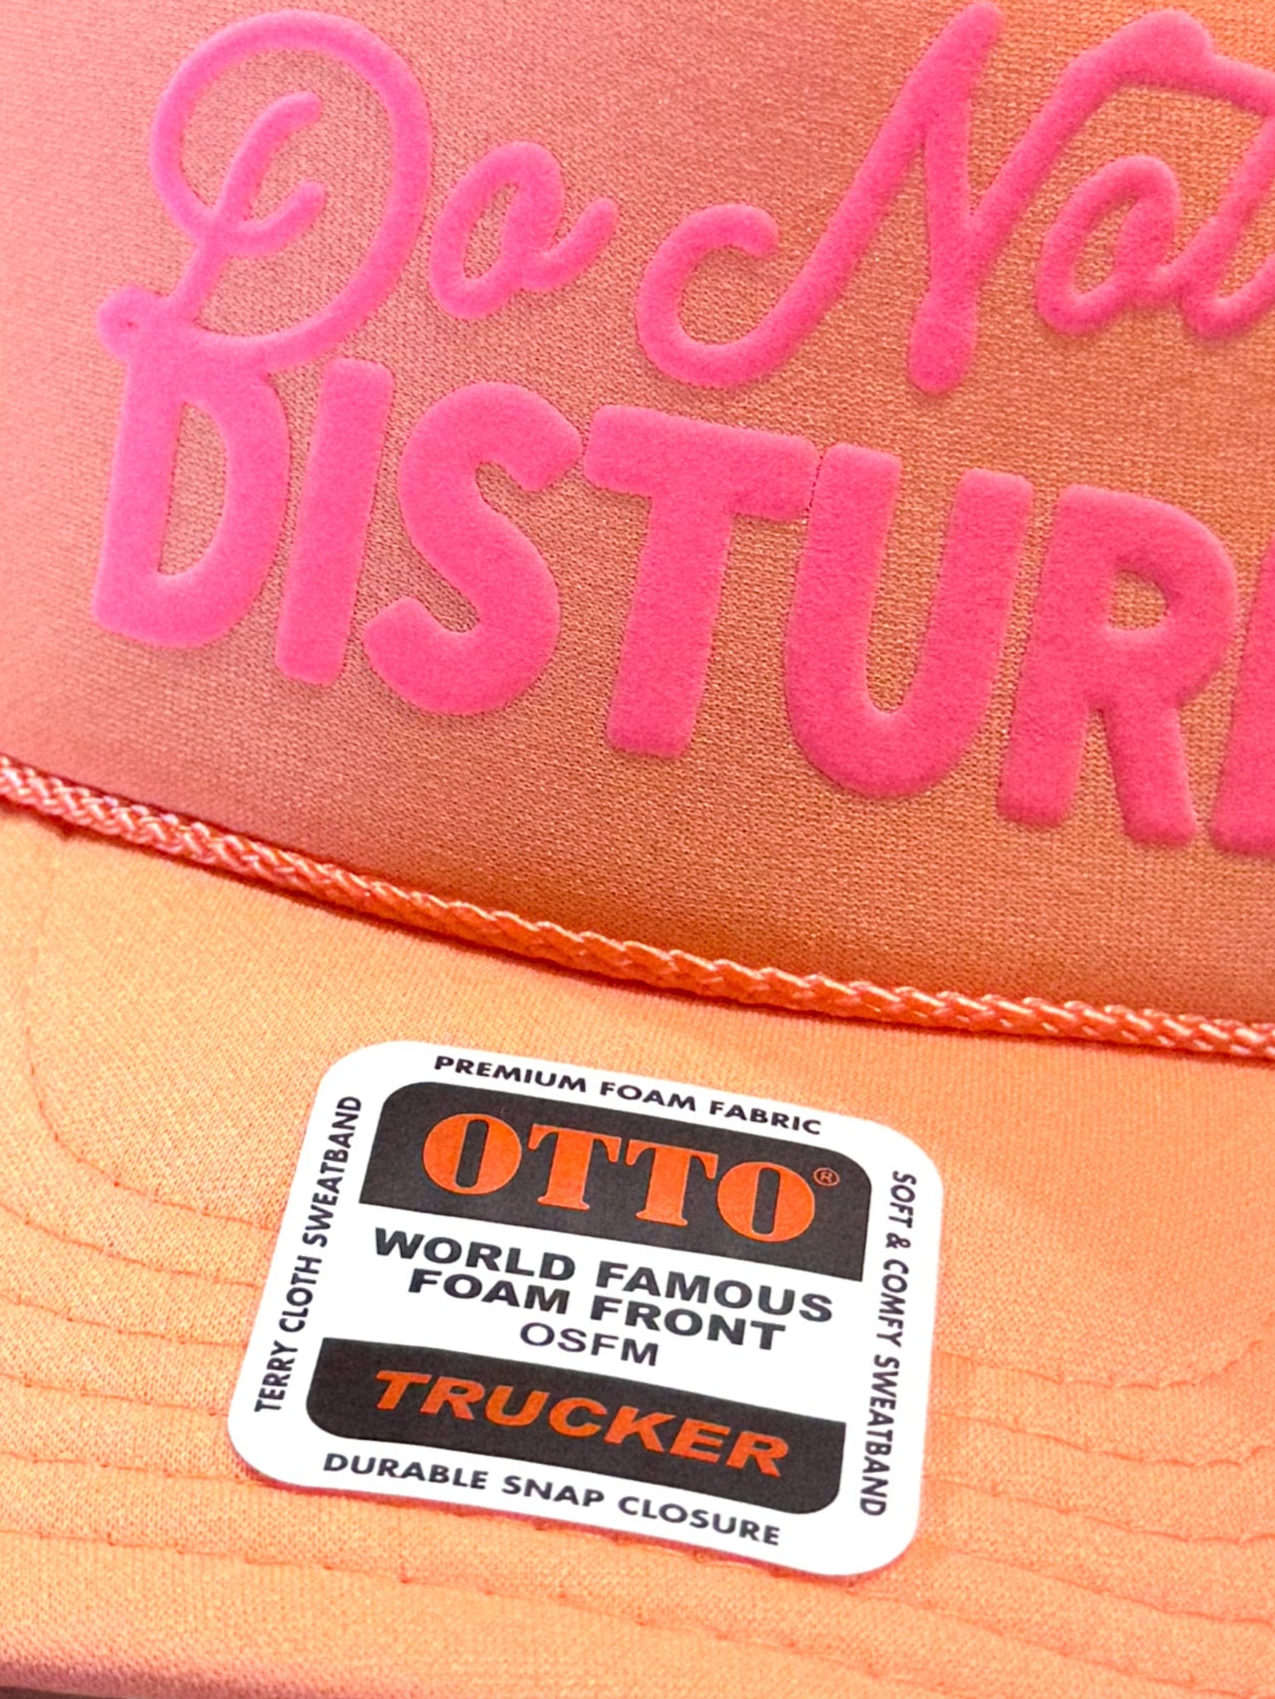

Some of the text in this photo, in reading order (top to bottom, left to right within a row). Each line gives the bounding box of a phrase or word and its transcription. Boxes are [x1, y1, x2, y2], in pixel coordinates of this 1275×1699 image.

[99, 10, 617, 371] Do
[435, 1056, 822, 1135] PREMIUM FOAM FABRIC
[255, 1096, 362, 1413] TERRY CLOTH SWEATBAND
[375, 1227, 833, 1323] WORLD FAMOUS
[408, 1269, 786, 1350] FOAM FRONT
[520, 1322, 659, 1366] OSFM
[860, 1170, 916, 1516] SOFT & COMFY SWEATBAND
[375, 1370, 790, 1477] TRUCKER
[324, 1453, 781, 1546] DURABLE SNAP CLOSURE
